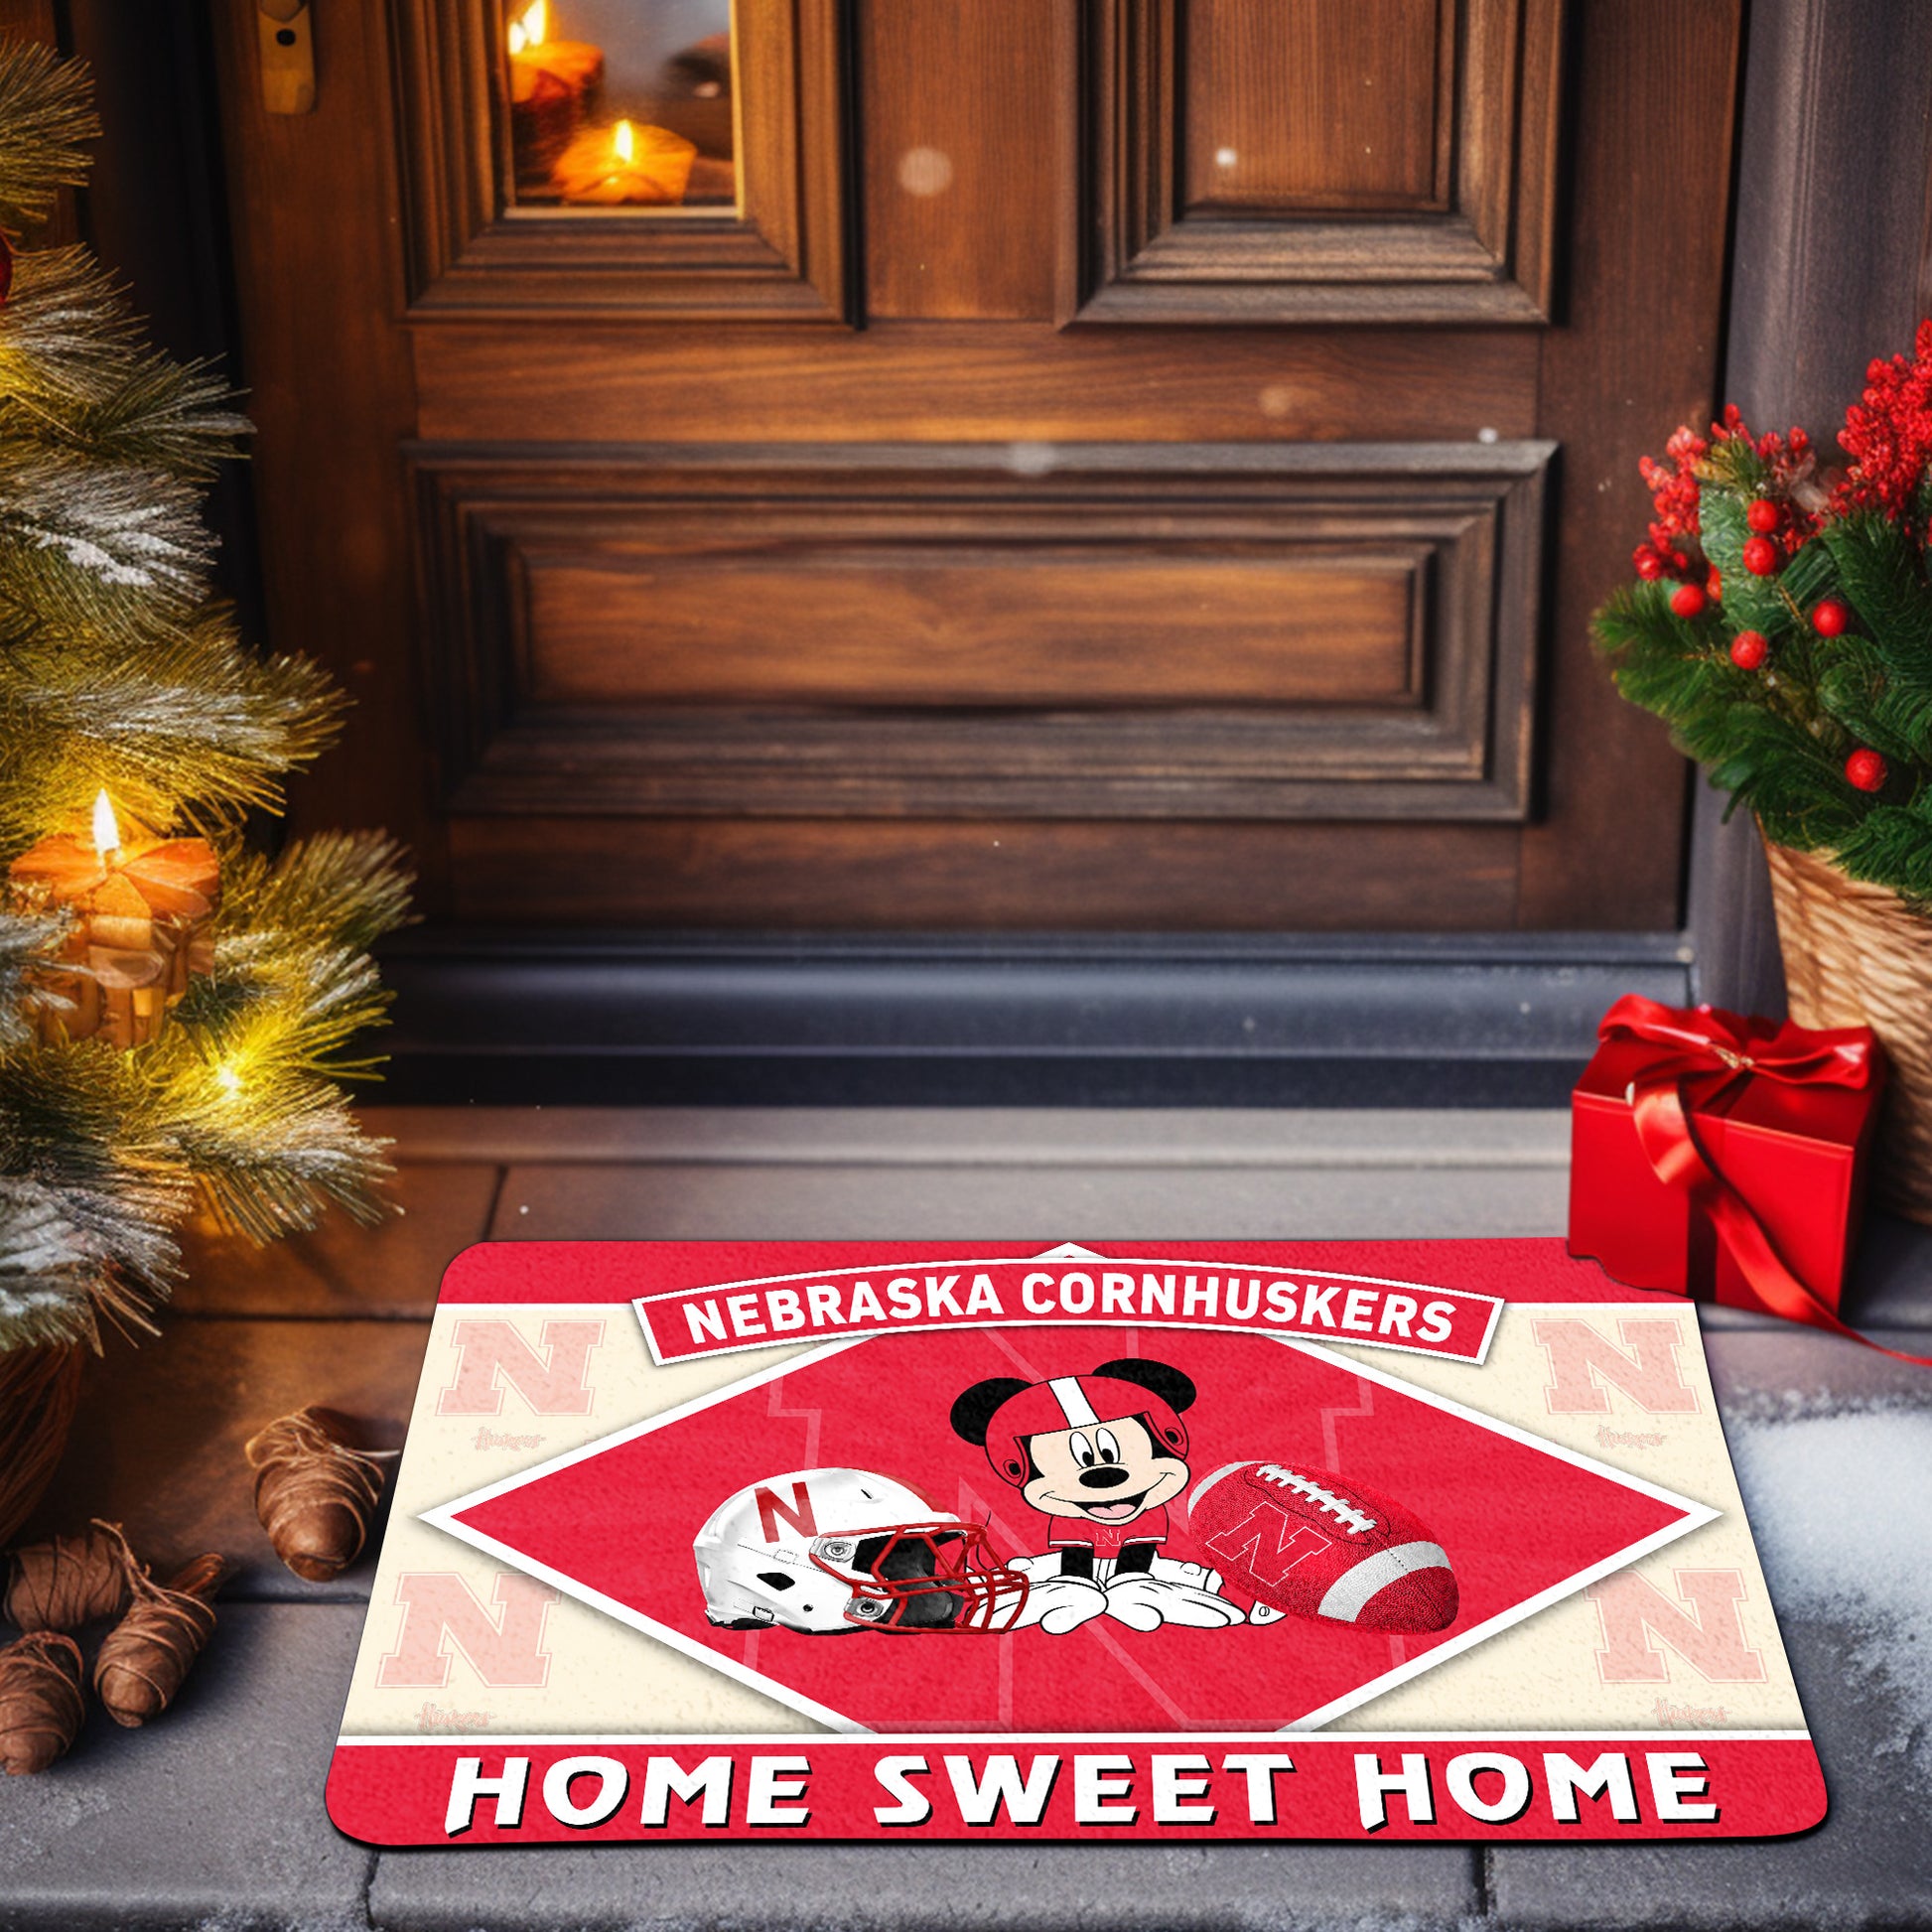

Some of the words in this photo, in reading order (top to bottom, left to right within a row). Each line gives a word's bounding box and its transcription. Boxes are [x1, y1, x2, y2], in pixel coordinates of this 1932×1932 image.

[682, 1273, 1005, 1344] NEBRASKA
[1022, 1272, 1456, 1343] CORNHUSKERS
[435, 1319, 607, 1416] N
[1530, 1318, 1703, 1415] N
[754, 1481, 818, 1543] N
[1095, 1528, 1121, 1546] N
[1205, 1501, 1332, 1587] N
[375, 1572, 561, 1688] N
[1582, 1569, 1768, 1684] N
[444, 1754, 813, 1837] HOME
[873, 1753, 1296, 1827] SWEET
[1353, 1751, 1721, 1834] HOME
